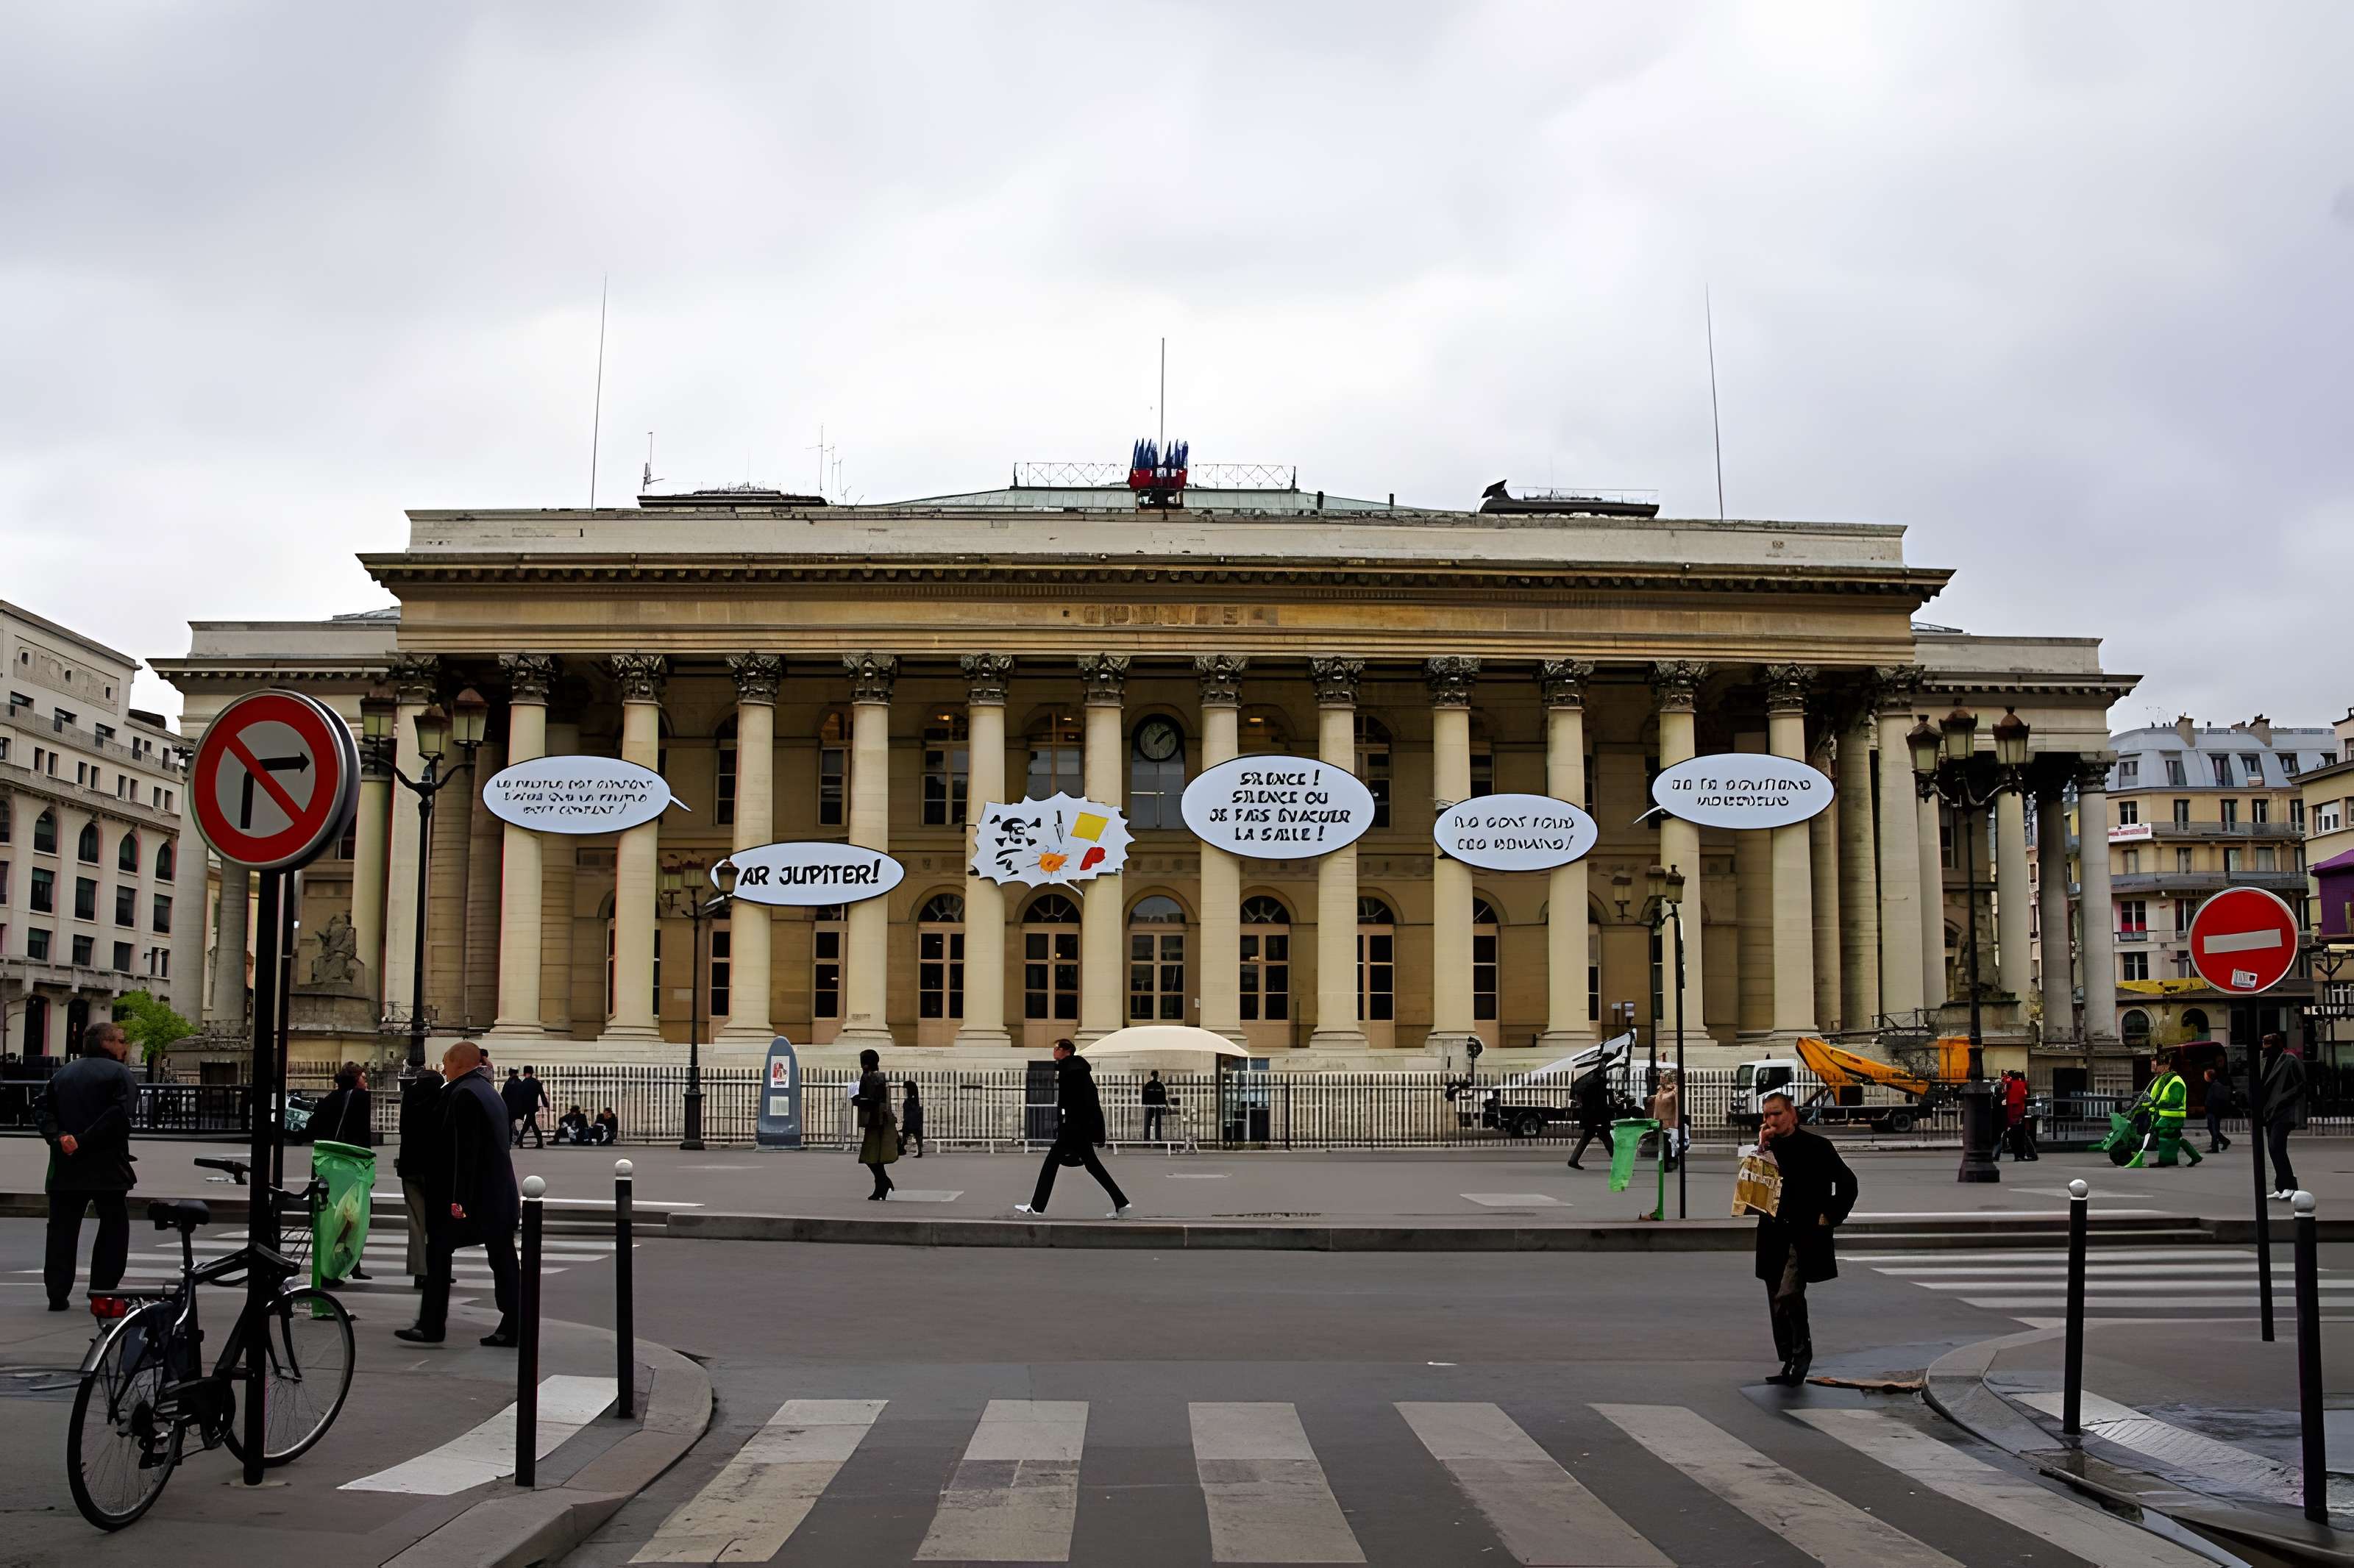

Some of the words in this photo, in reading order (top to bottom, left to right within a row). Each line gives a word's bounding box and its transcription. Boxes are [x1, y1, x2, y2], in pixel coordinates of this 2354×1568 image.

[1304, 791, 1329, 805] OU
[1234, 827, 1254, 841] LA
[739, 865, 770, 886] AR
